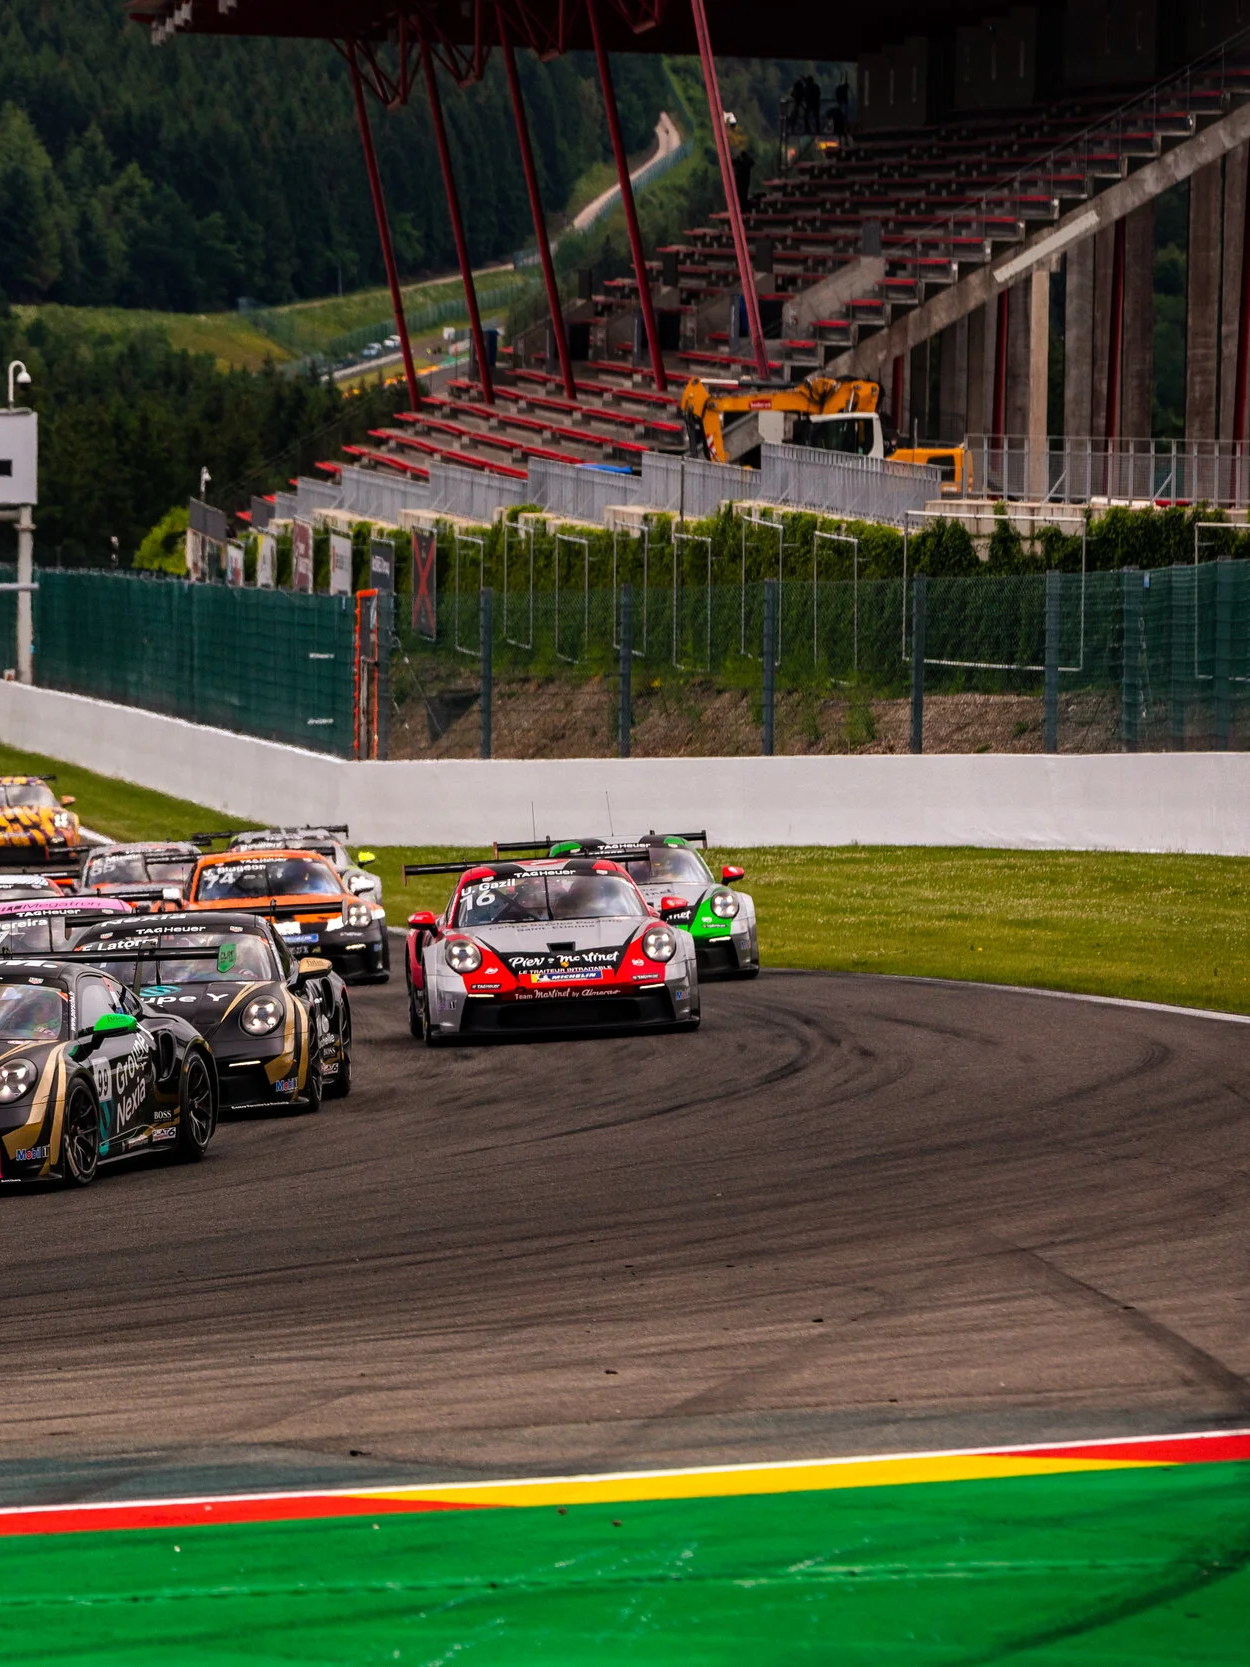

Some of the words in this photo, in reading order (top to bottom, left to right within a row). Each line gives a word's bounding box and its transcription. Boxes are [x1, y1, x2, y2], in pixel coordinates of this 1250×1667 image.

[478, 878, 516, 892] Gazil
[459, 890, 496, 911] 16
[551, 972, 597, 980] MICHELIN
[515, 992, 534, 1000] Team
[116, 1077, 146, 1134] Nexia
[153, 1110, 172, 1120] BOSS
[16, 1148, 42, 1161] Mobil
